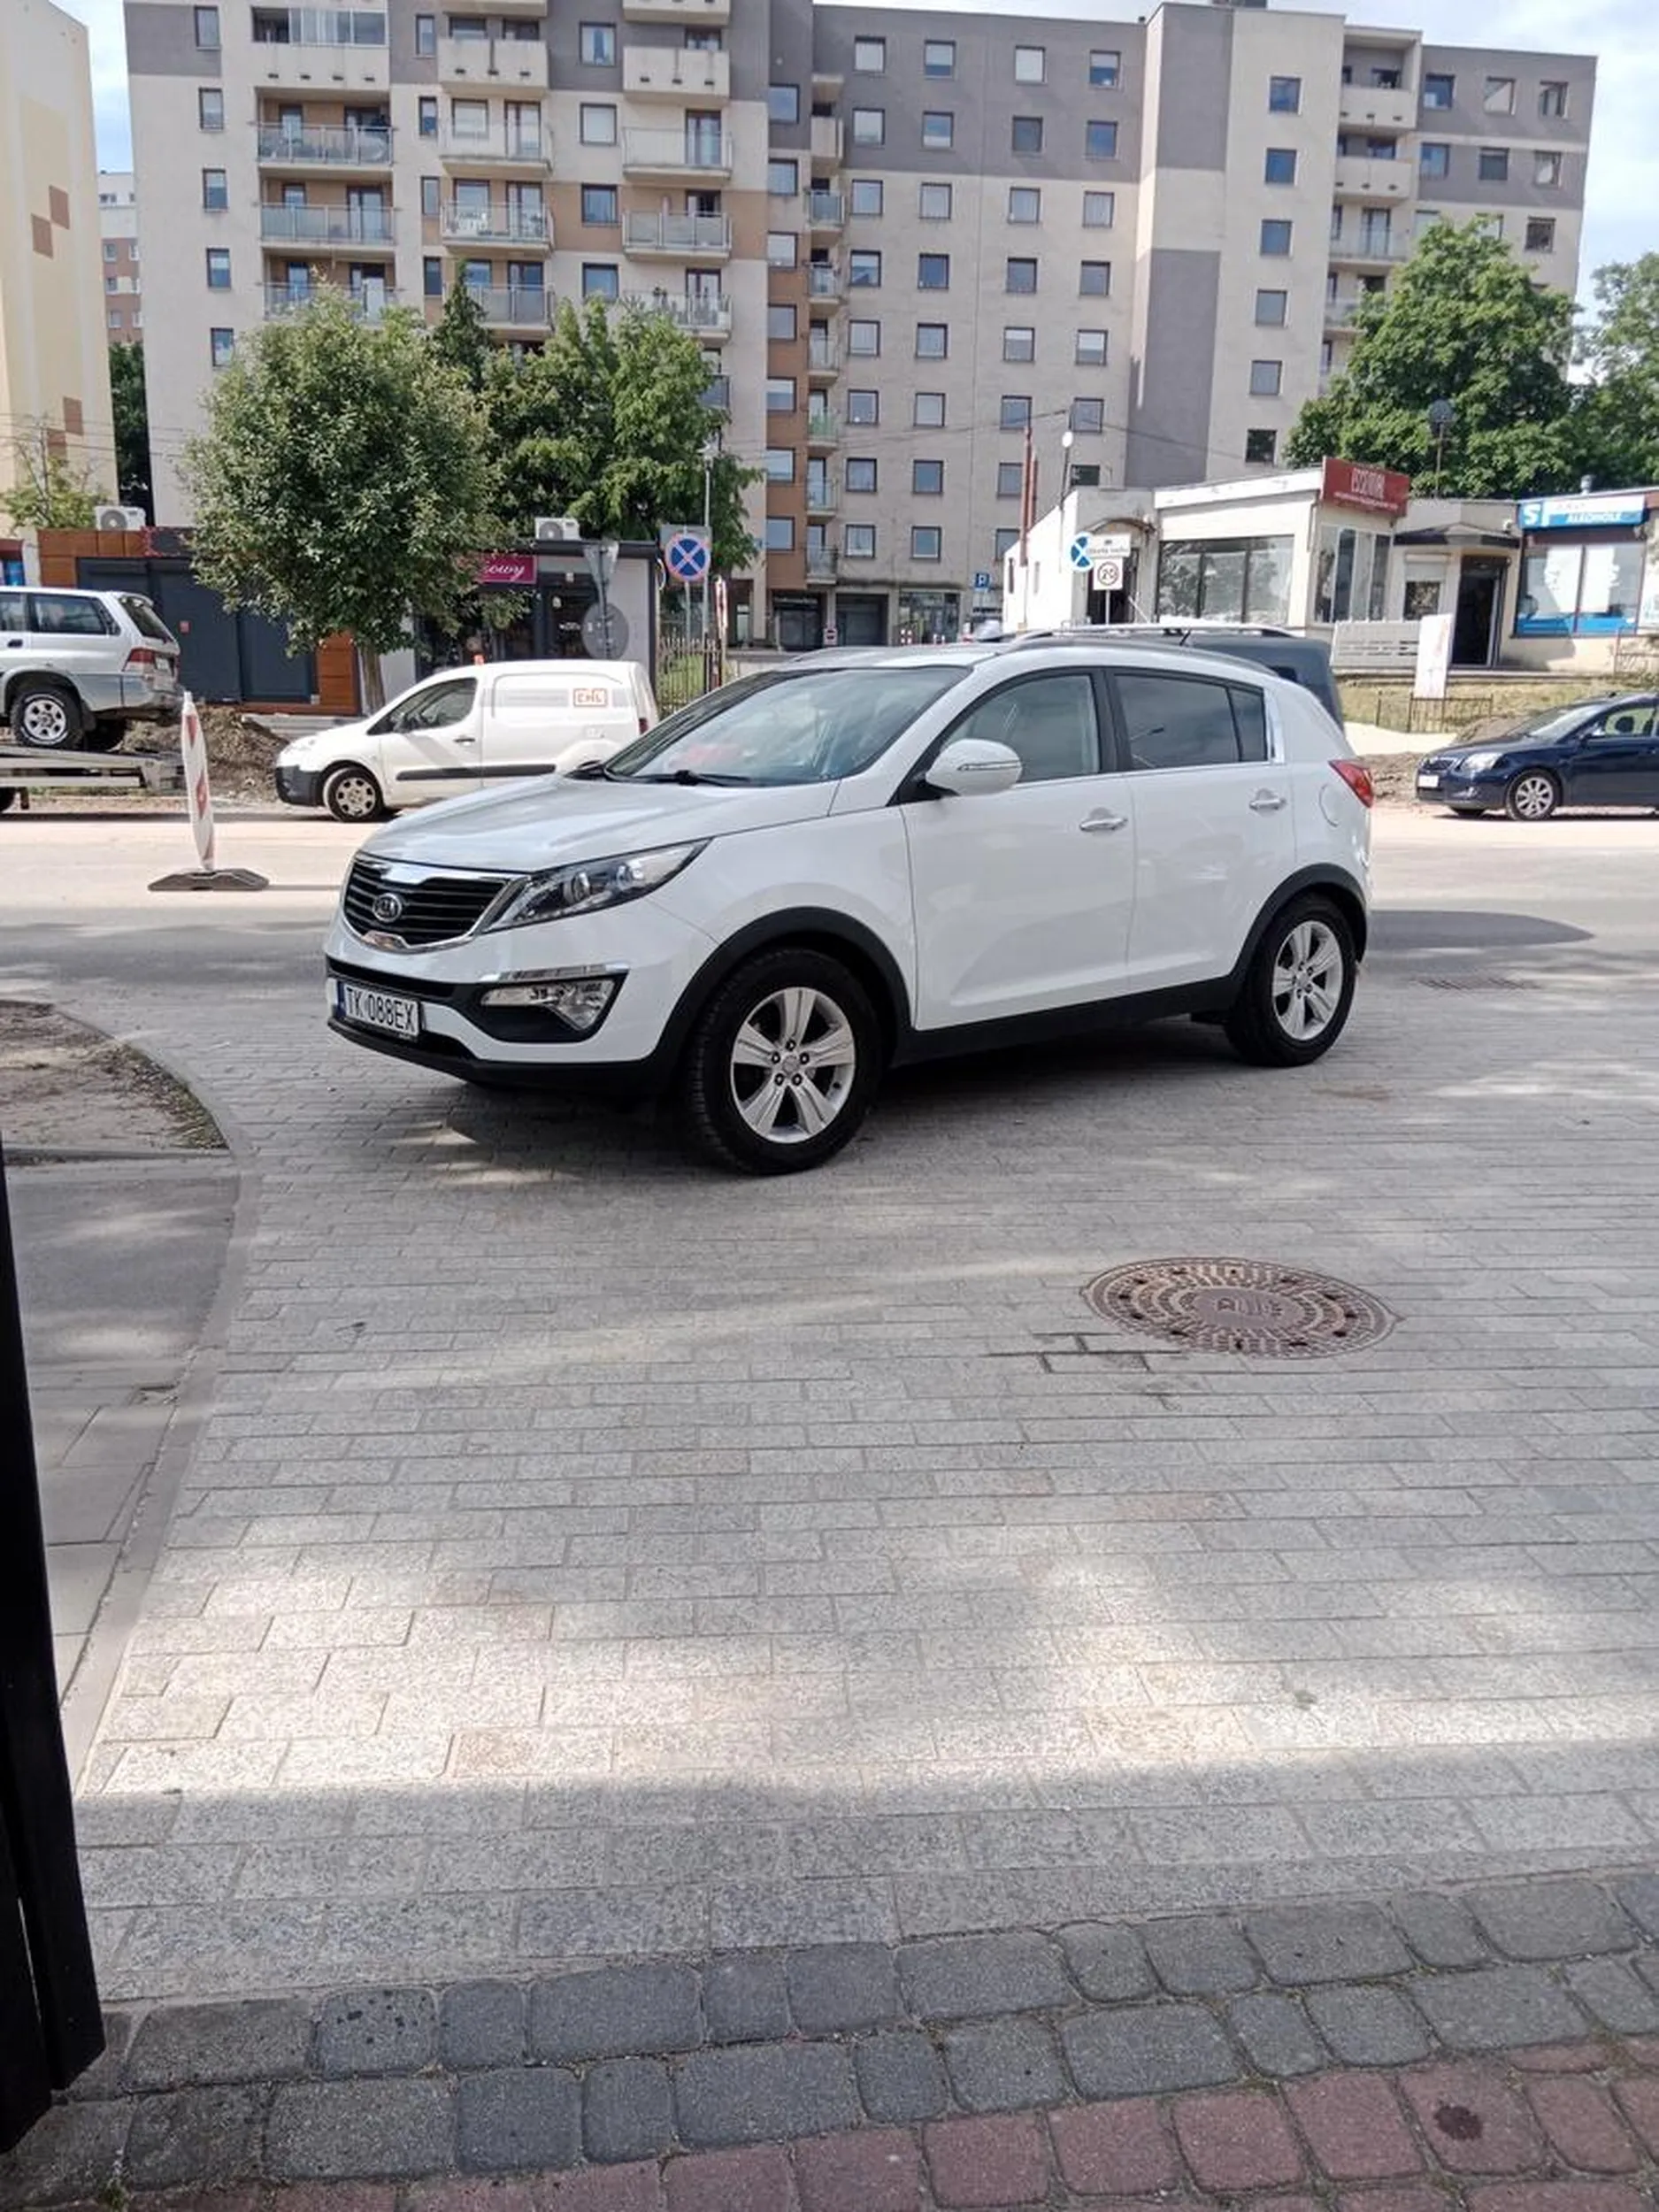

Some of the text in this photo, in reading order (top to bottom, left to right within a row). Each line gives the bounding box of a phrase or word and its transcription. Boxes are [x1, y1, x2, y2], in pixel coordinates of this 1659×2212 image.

[979, 573, 988, 587] P
[346, 987, 415, 1033] TK 088EX
